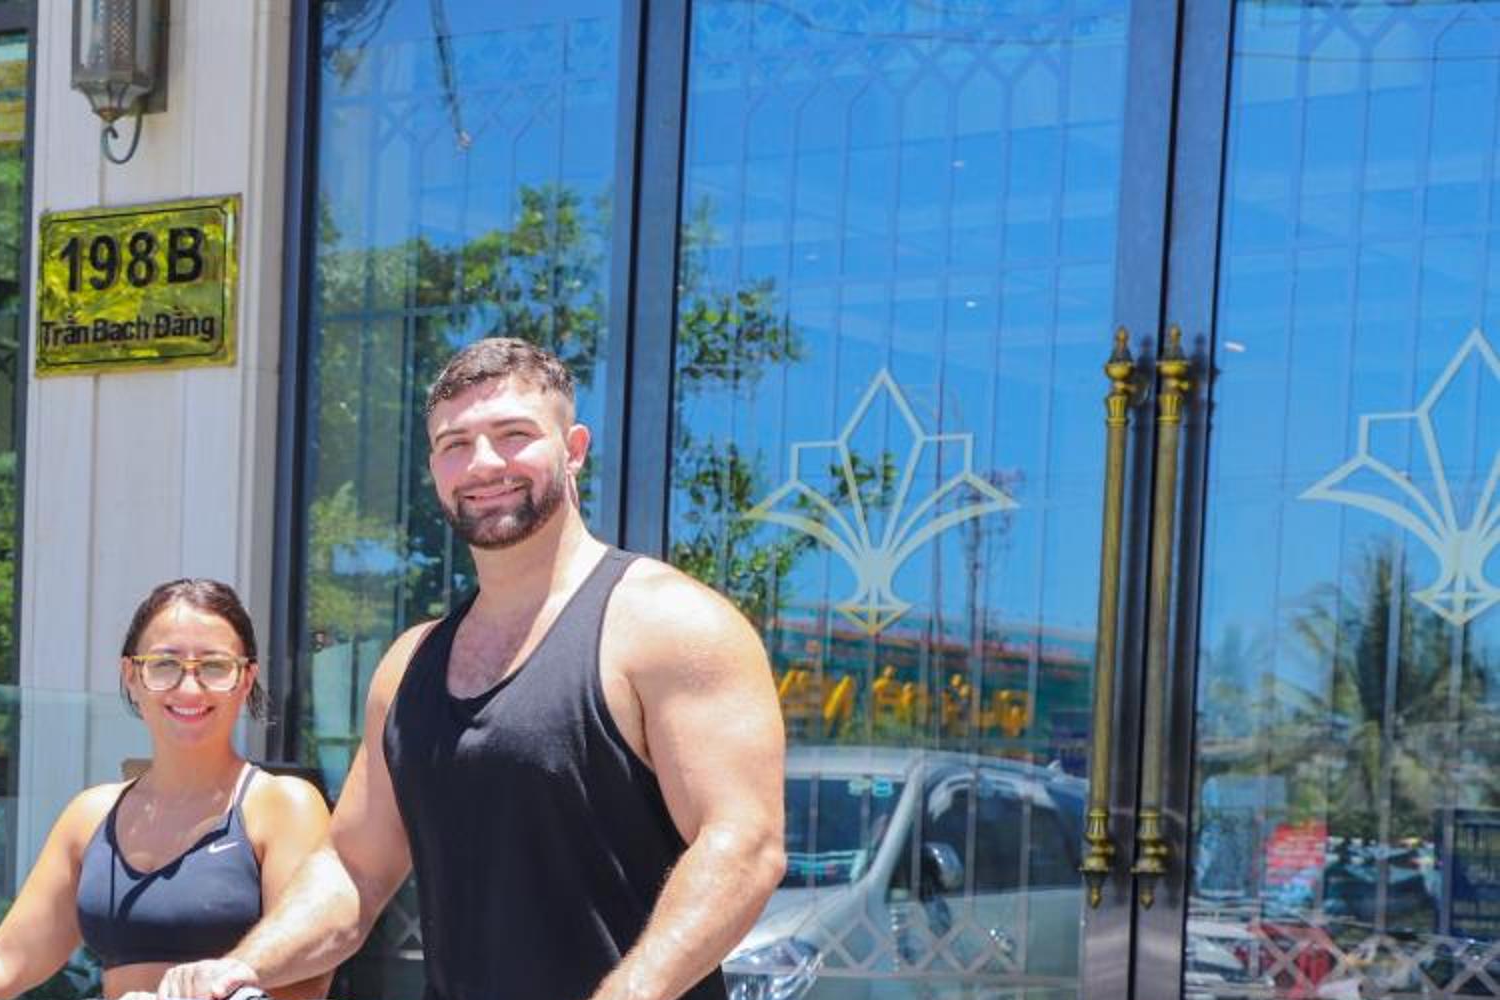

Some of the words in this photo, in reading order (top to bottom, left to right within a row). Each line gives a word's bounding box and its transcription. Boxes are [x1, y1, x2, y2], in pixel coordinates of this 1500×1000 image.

[60, 226, 204, 292] 198B
[41, 314, 90, 346] Trần
[93, 314, 149, 348] Bạch
